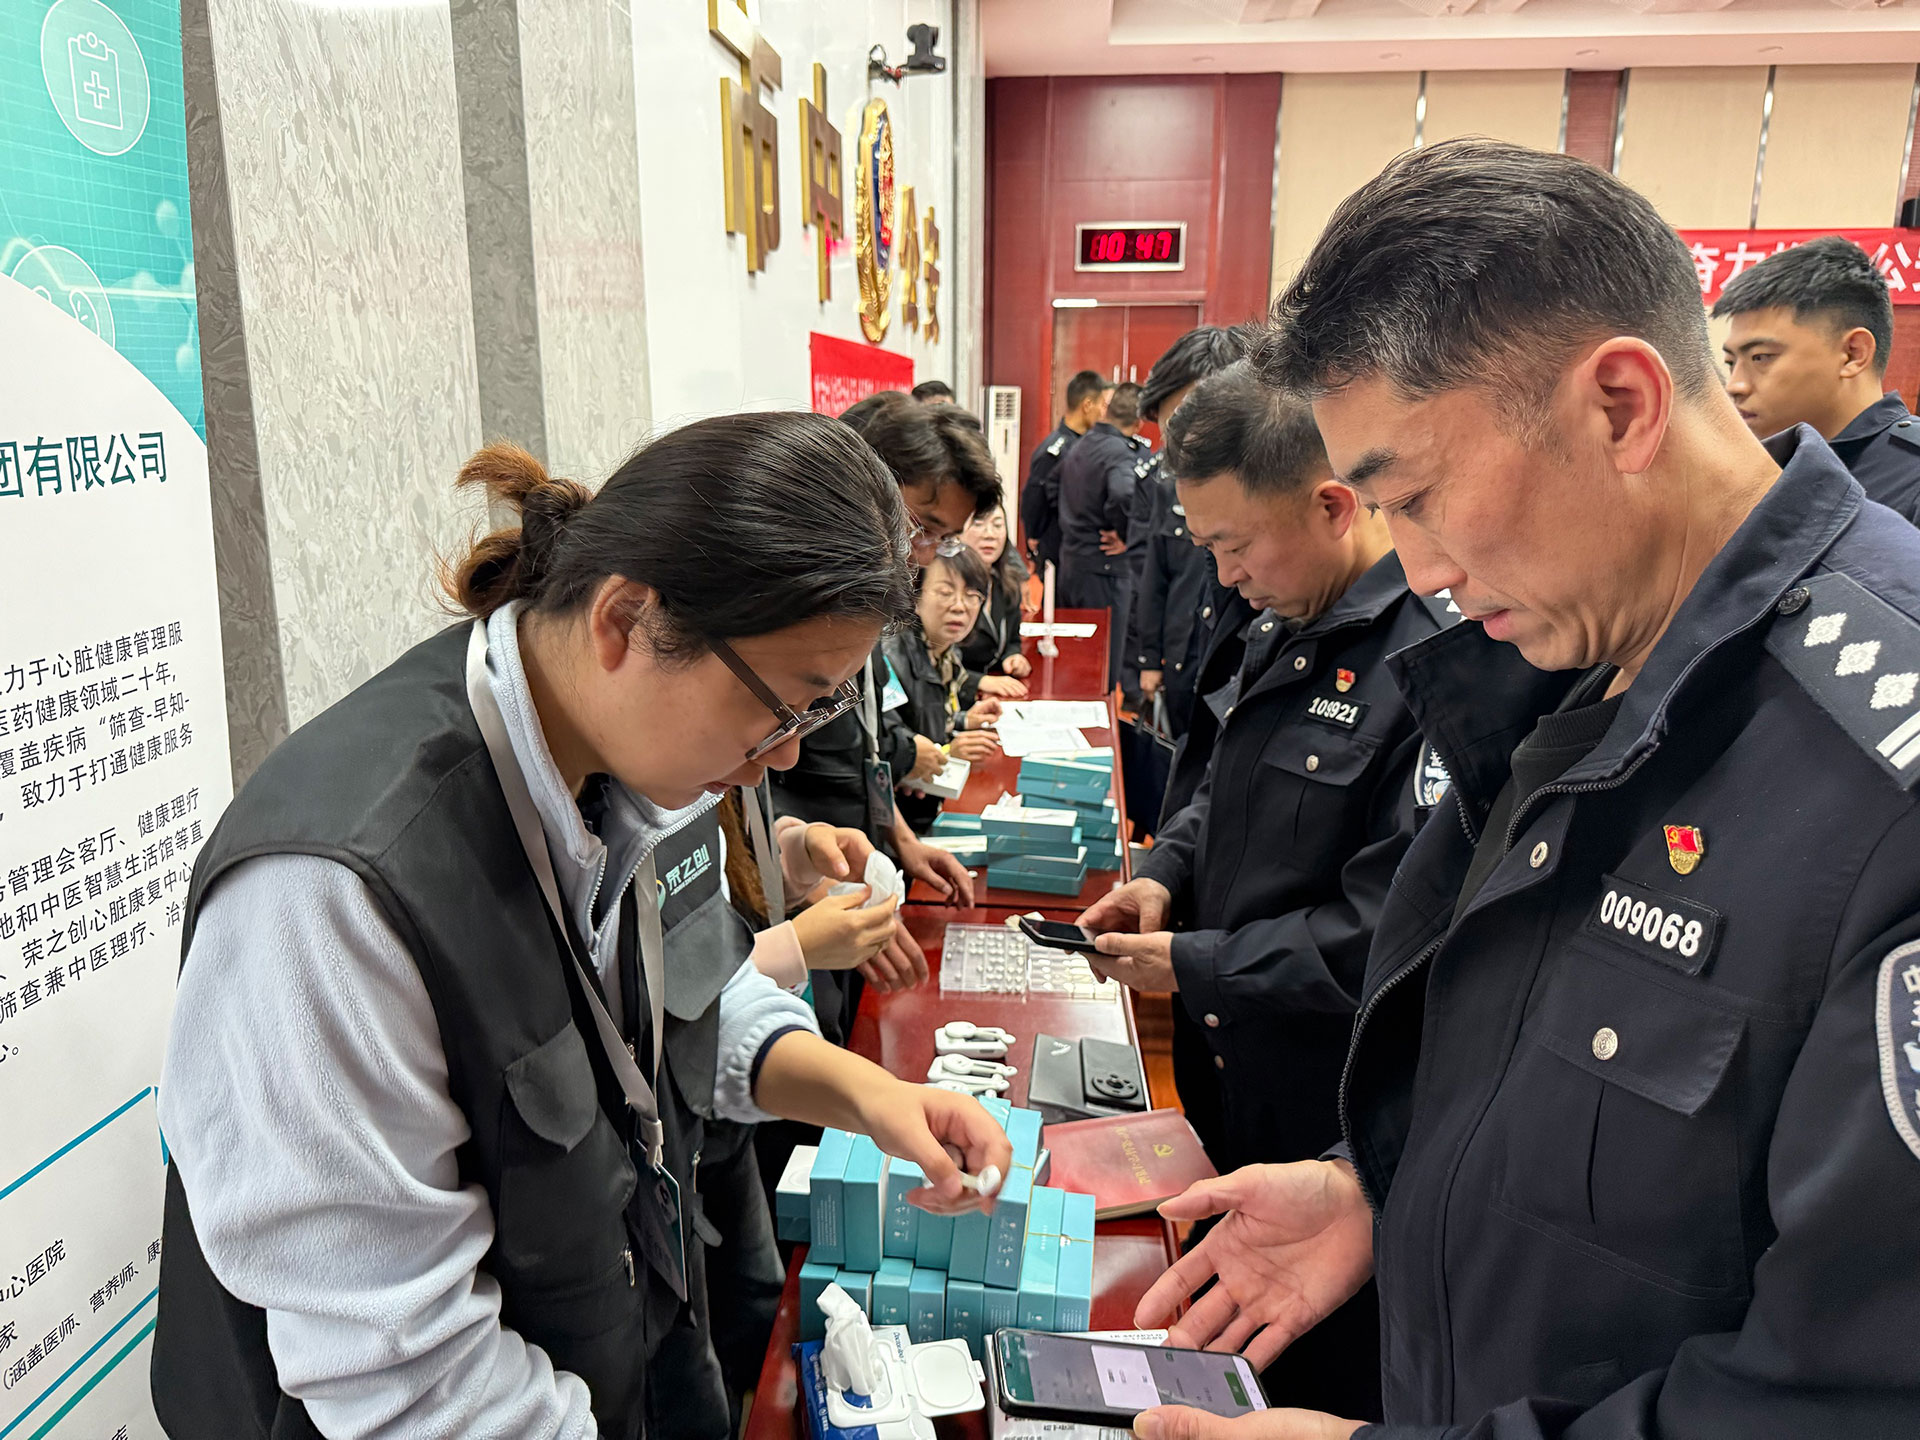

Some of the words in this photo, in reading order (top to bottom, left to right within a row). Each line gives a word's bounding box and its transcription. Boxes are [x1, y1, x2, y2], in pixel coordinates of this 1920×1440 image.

[0, 431, 167, 498] 团有限公司
[0, 621, 183, 695] 力于心脏健康管理服
[0, 787, 200, 902] 管理会客厅、健康理疗
[1600, 890, 1703, 957] 009068
[0, 896, 188, 1024] 筛查兼中医理疗、治
[0, 1238, 66, 1302] 心医院
